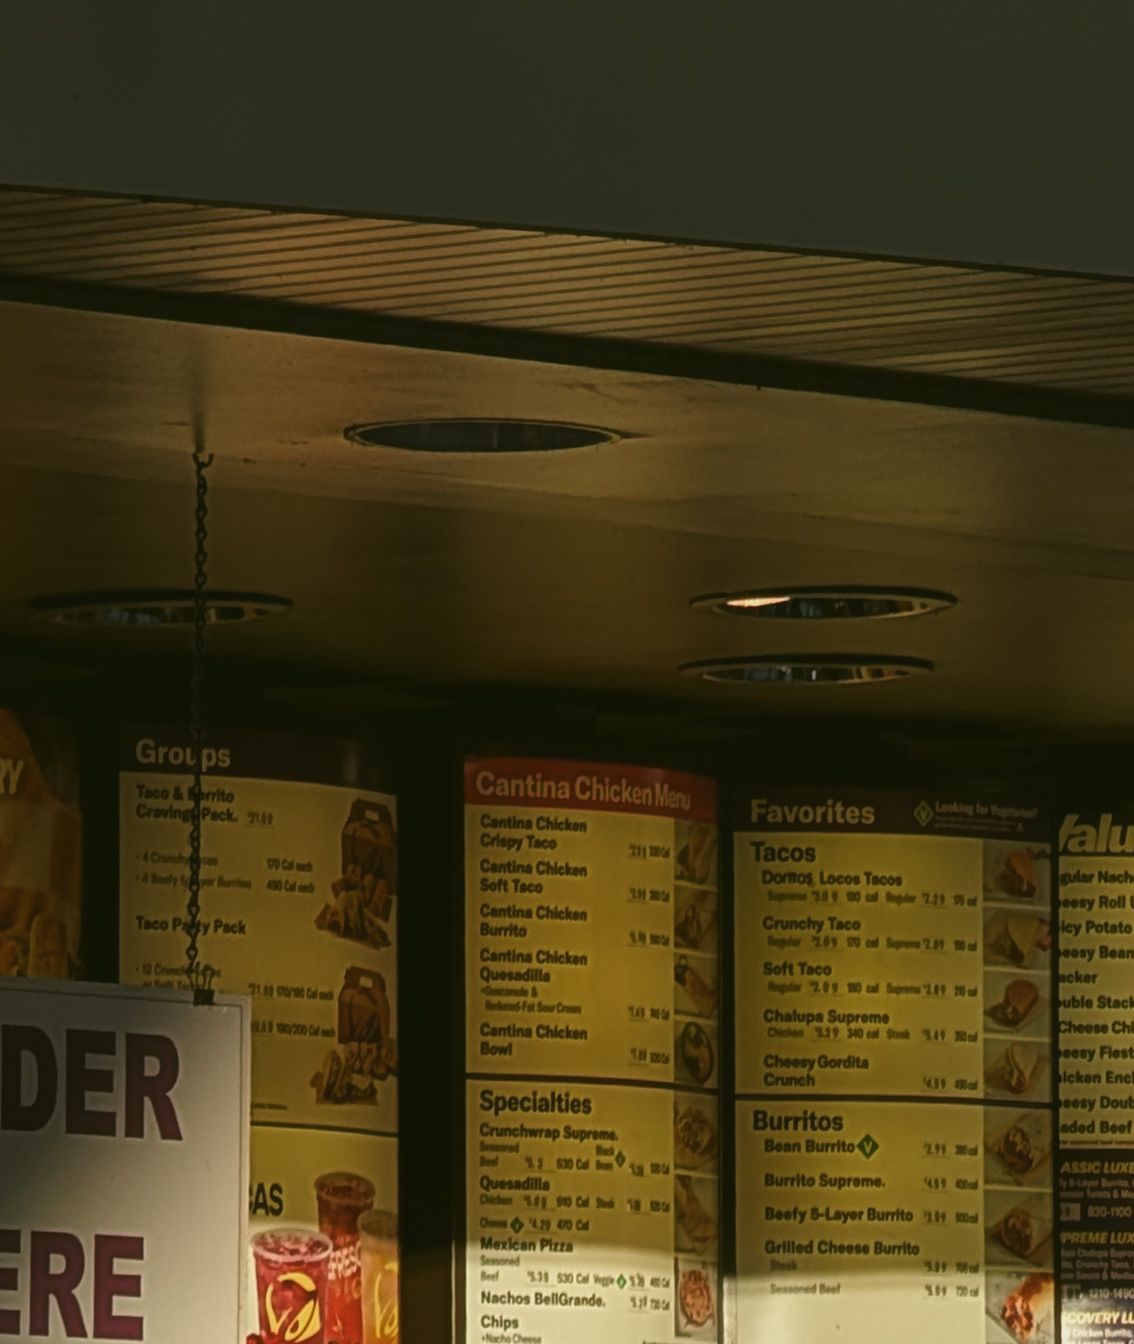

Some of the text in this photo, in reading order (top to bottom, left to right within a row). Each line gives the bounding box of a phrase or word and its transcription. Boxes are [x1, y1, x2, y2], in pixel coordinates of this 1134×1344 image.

[136, 784, 235, 803] Taco & Brrito
[475, 770, 692, 811] Cantina Chicken Menu
[751, 798, 876, 825] Favorites
[480, 814, 587, 833] Cantina Chicken
[480, 834, 557, 851] Crispy Taco
[751, 841, 816, 863] Tacos
[480, 858, 587, 877] Cantina Chicken
[480, 879, 543, 895] Soft Taco
[820, 872, 861, 886] Locos
[864, 872, 903, 886] Tacos
[1099, 895, 1126, 909] Roll
[480, 903, 588, 922] Cantina Chicken
[136, 915, 247, 936] Taco Paty Pack
[480, 922, 527, 938] Burrito
[762, 916, 861, 934] Crunchy Taco
[1058, 920, 1082, 936] icy
[1085, 920, 1132, 934] Potato
[480, 948, 588, 966] Cantina Chicken
[1099, 945, 1134, 959] Bean
[480, 966, 551, 984] Quesadilla
[763, 961, 832, 976] Soft Taco
[763, 1008, 889, 1026] Chalupa Supreme
[480, 1023, 588, 1040] Cantina Chicken
[1059, 1020, 1109, 1034] Cheese
[480, 1041, 513, 1056] Bowl
[763, 1054, 869, 1071] Cheesy Gordita
[0, 1024, 183, 1141] DER
[763, 1073, 816, 1087] Crunch
[480, 1089, 592, 1115] Specialties
[753, 1109, 844, 1132] Burritos
[1100, 1121, 1132, 1134] Beef
[480, 1124, 560, 1142] Crunchwrap
[764, 1138, 801, 1153] Bean
[805, 1138, 856, 1153] Burrito
[480, 1176, 550, 1191] Quesadilla
[764, 1173, 816, 1187] Burrito
[764, 1206, 806, 1224] Beefy
[810, 1207, 864, 1224] 5-Layer
[866, 1206, 914, 1222] Burrito
[480, 1237, 573, 1252] Mexican Pizza
[764, 1239, 921, 1256] Grilled Cheese Burrito
[576, 1272, 589, 1284] Cal
[481, 1291, 531, 1306] Nachos
[769, 1284, 816, 1295] Seasoned
[819, 1284, 842, 1296] Beef
[481, 1315, 519, 1332] Chips
[512, 1333, 542, 1344] Cheese
